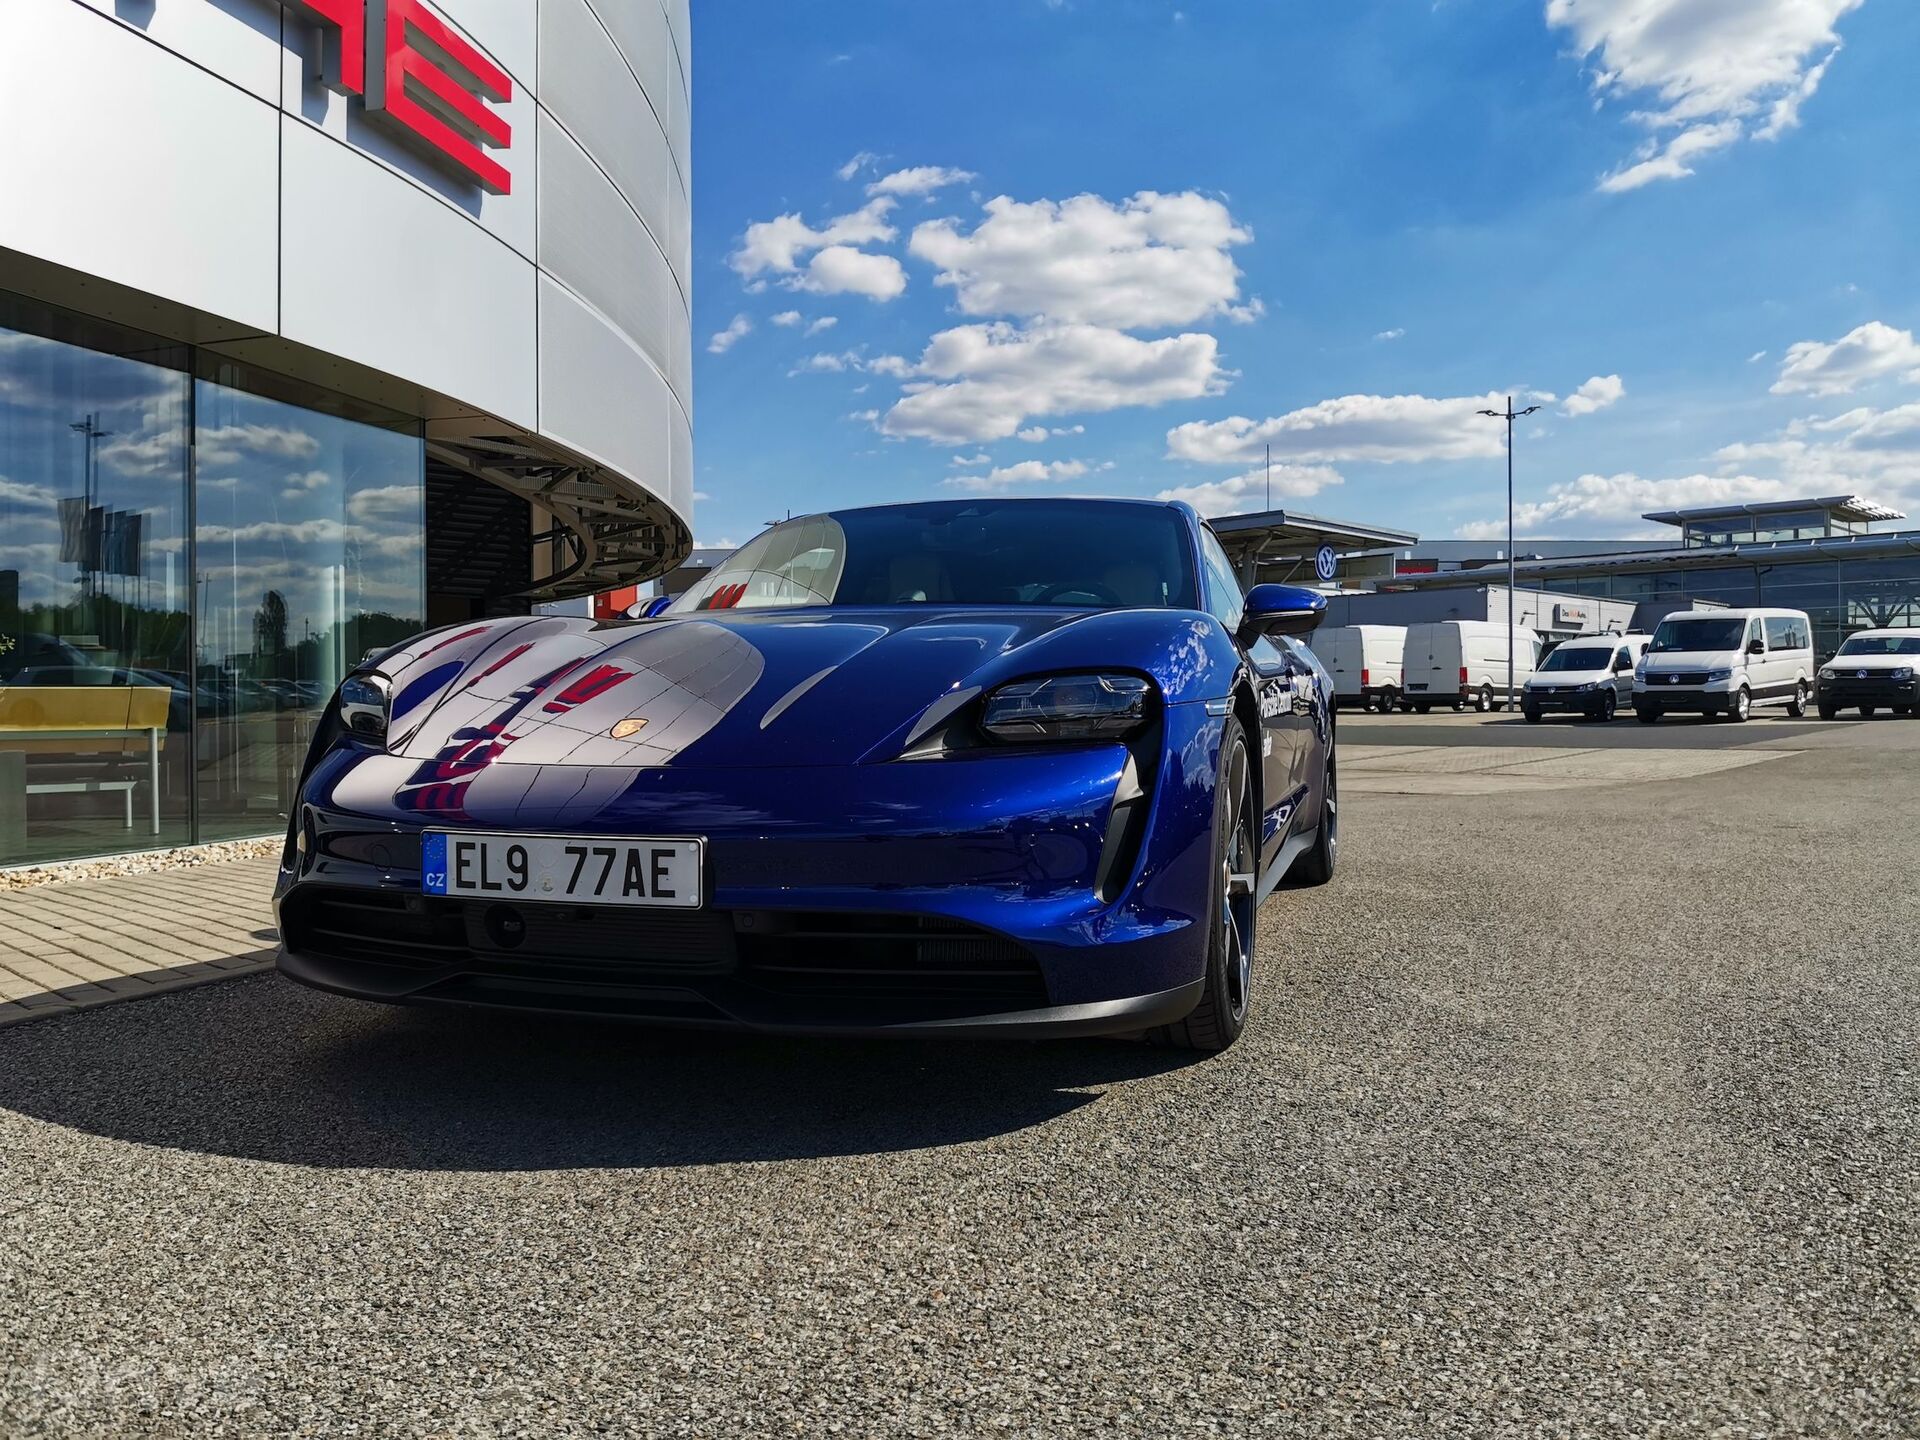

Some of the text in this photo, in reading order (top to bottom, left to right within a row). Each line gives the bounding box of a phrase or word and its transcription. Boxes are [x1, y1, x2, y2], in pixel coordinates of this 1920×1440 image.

[426, 872, 445, 887] CZ
[455, 841, 676, 898] EL9 77AE
